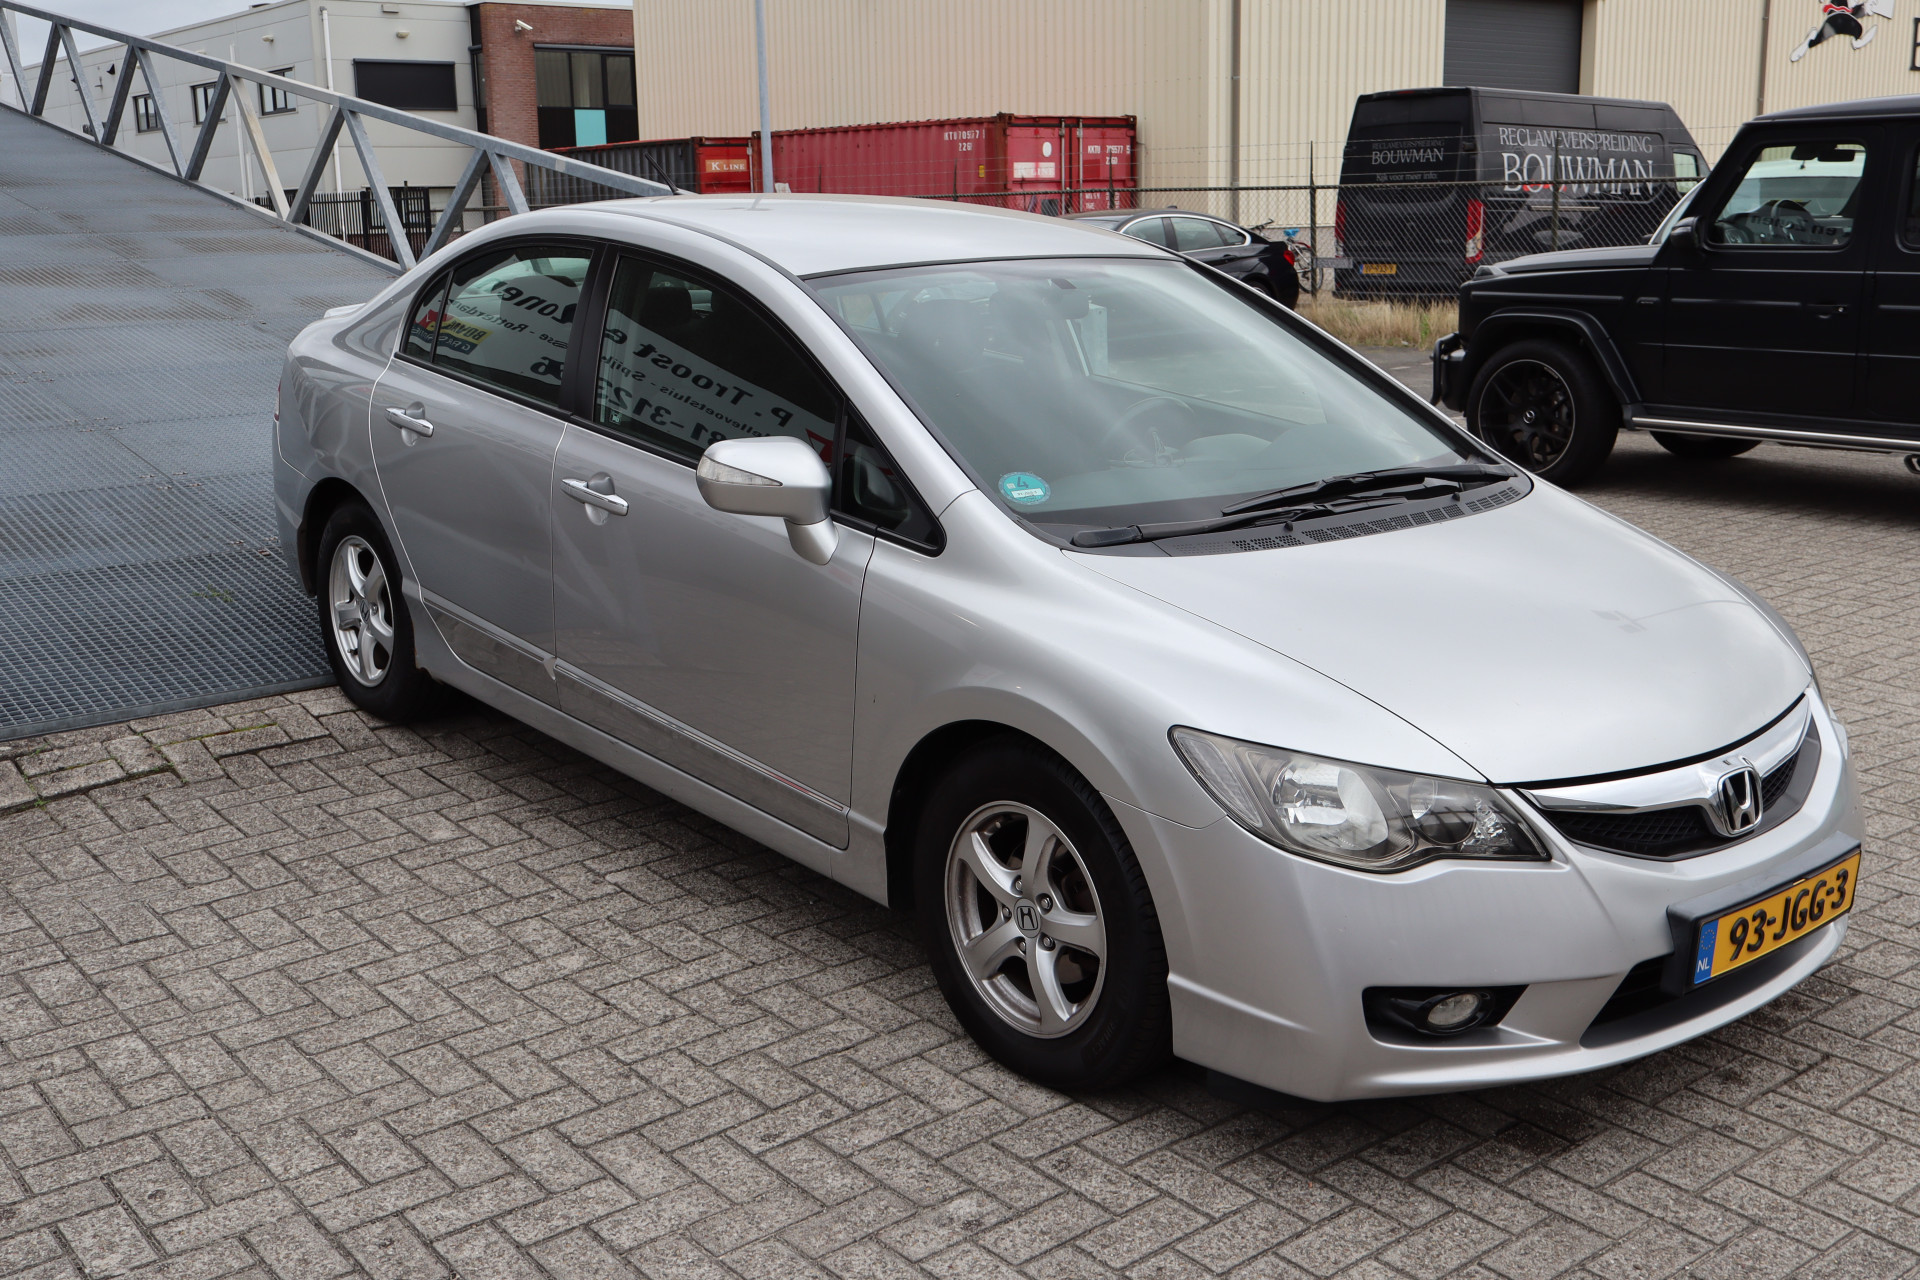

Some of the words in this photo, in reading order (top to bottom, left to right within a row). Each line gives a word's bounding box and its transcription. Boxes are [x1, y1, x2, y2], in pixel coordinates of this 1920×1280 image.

[1498, 127, 1653, 153] RECLAMEVERSPREIDING
[711, 161, 721, 171] K
[1371, 148, 1444, 165] BOUWMAN
[1501, 152, 1654, 196] BOUWMAN
[1729, 868, 1849, 962] 93-JGG-3
[1697, 957, 1710, 973] NL
